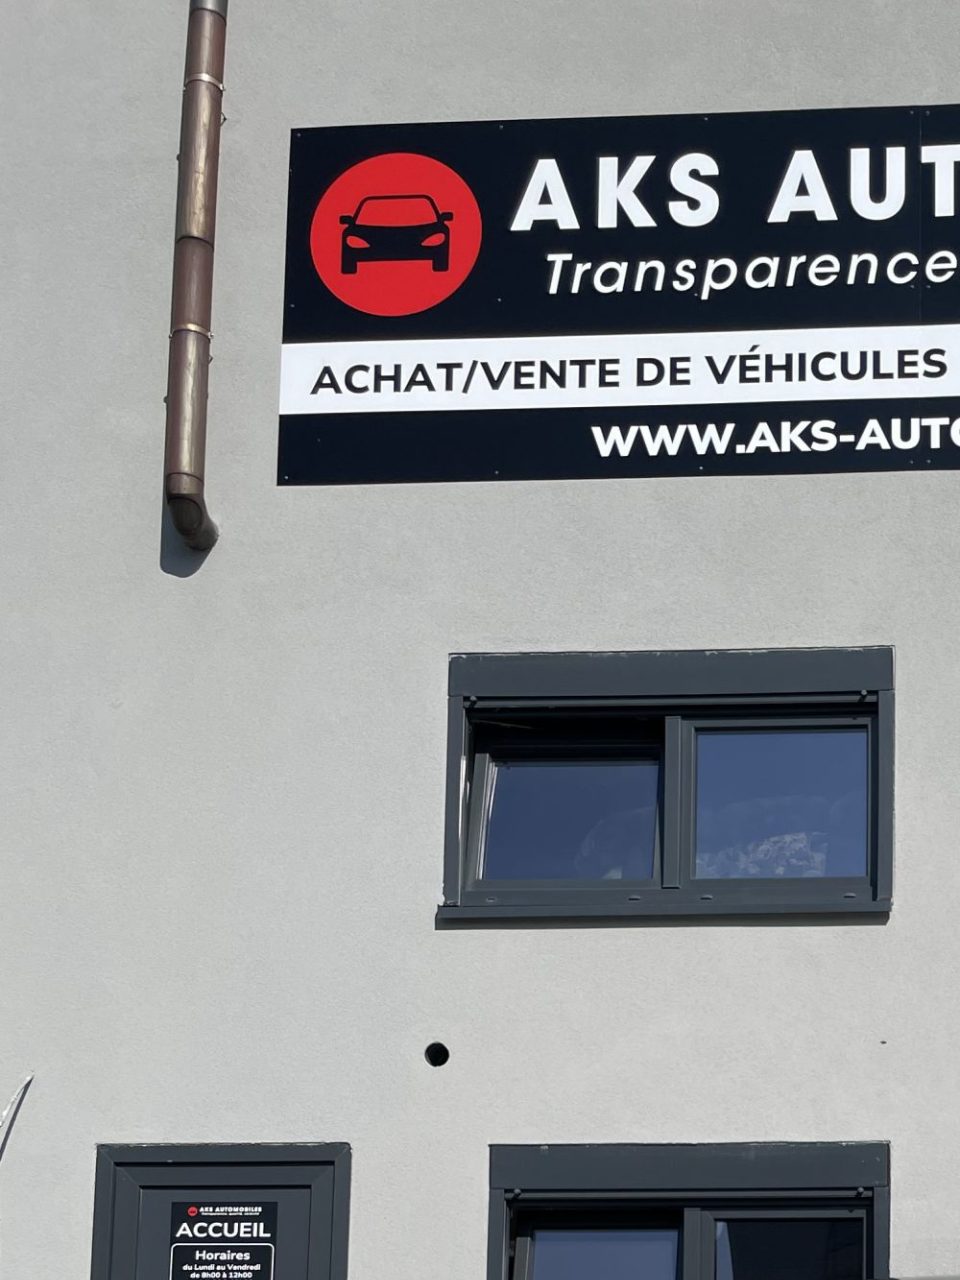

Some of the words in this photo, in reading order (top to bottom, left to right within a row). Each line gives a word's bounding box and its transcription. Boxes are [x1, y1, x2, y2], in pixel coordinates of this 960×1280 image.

[511, 153, 720, 232] AKS
[310, 358, 620, 395] ACHAT/VENTE
[636, 356, 691, 387] DE
[704, 344, 948, 385] VÉHICULES
[175, 1222, 271, 1237] ACCUEIL
[195, 1250, 250, 1260] Horaires
